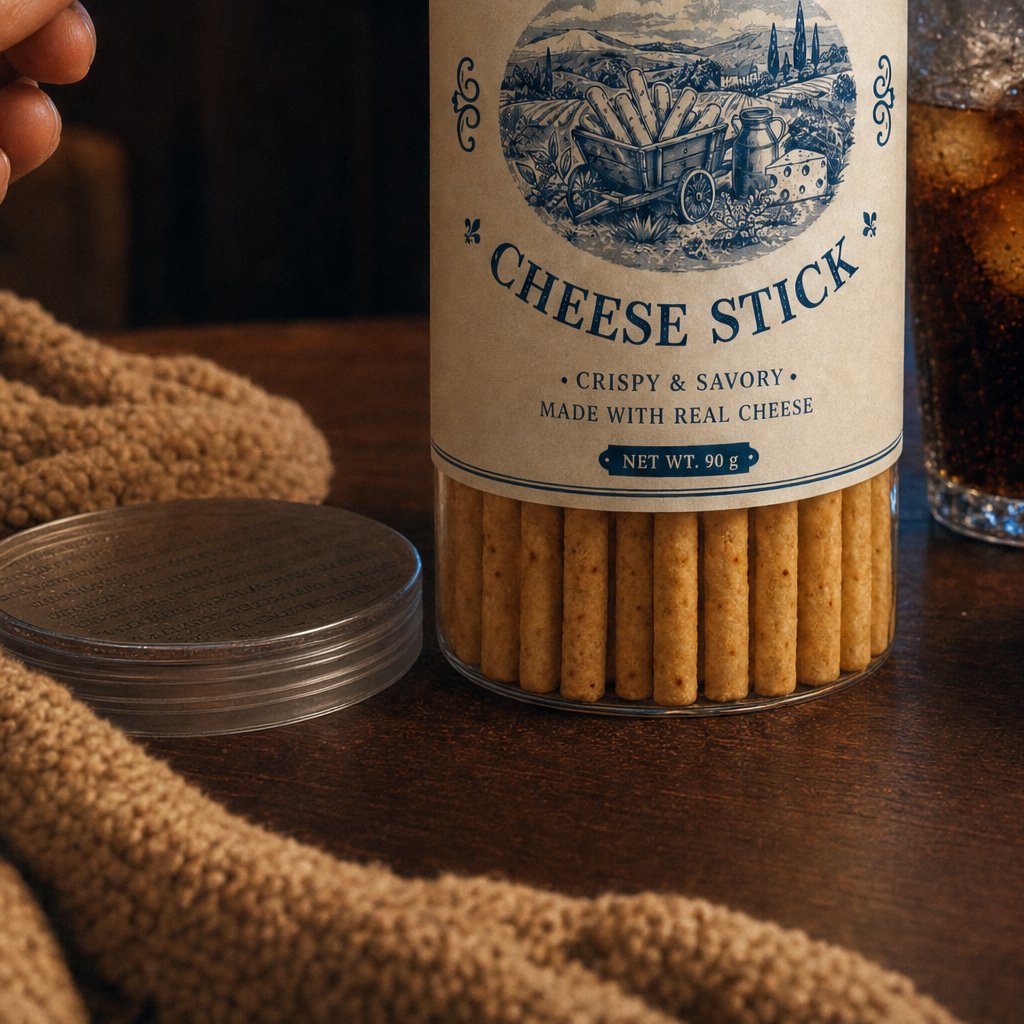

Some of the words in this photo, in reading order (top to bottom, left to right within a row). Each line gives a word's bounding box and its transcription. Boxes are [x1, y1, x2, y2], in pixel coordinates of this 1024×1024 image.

[490, 242, 688, 347] CHEESE
[710, 235, 860, 344] STICK
[576, 371, 660, 392] CRISPY
[669, 374, 686, 392] &
[696, 368, 784, 391] SAVORY
[540, 400, 598, 422] MADE
[607, 407, 664, 425] WITH
[674, 406, 730, 425] REAL
[738, 397, 814, 421] CHEESE
[622, 453, 659, 469] NET
[665, 453, 699, 469] WT.
[705, 453, 724, 468] 90
[729, 455, 739, 470] g
